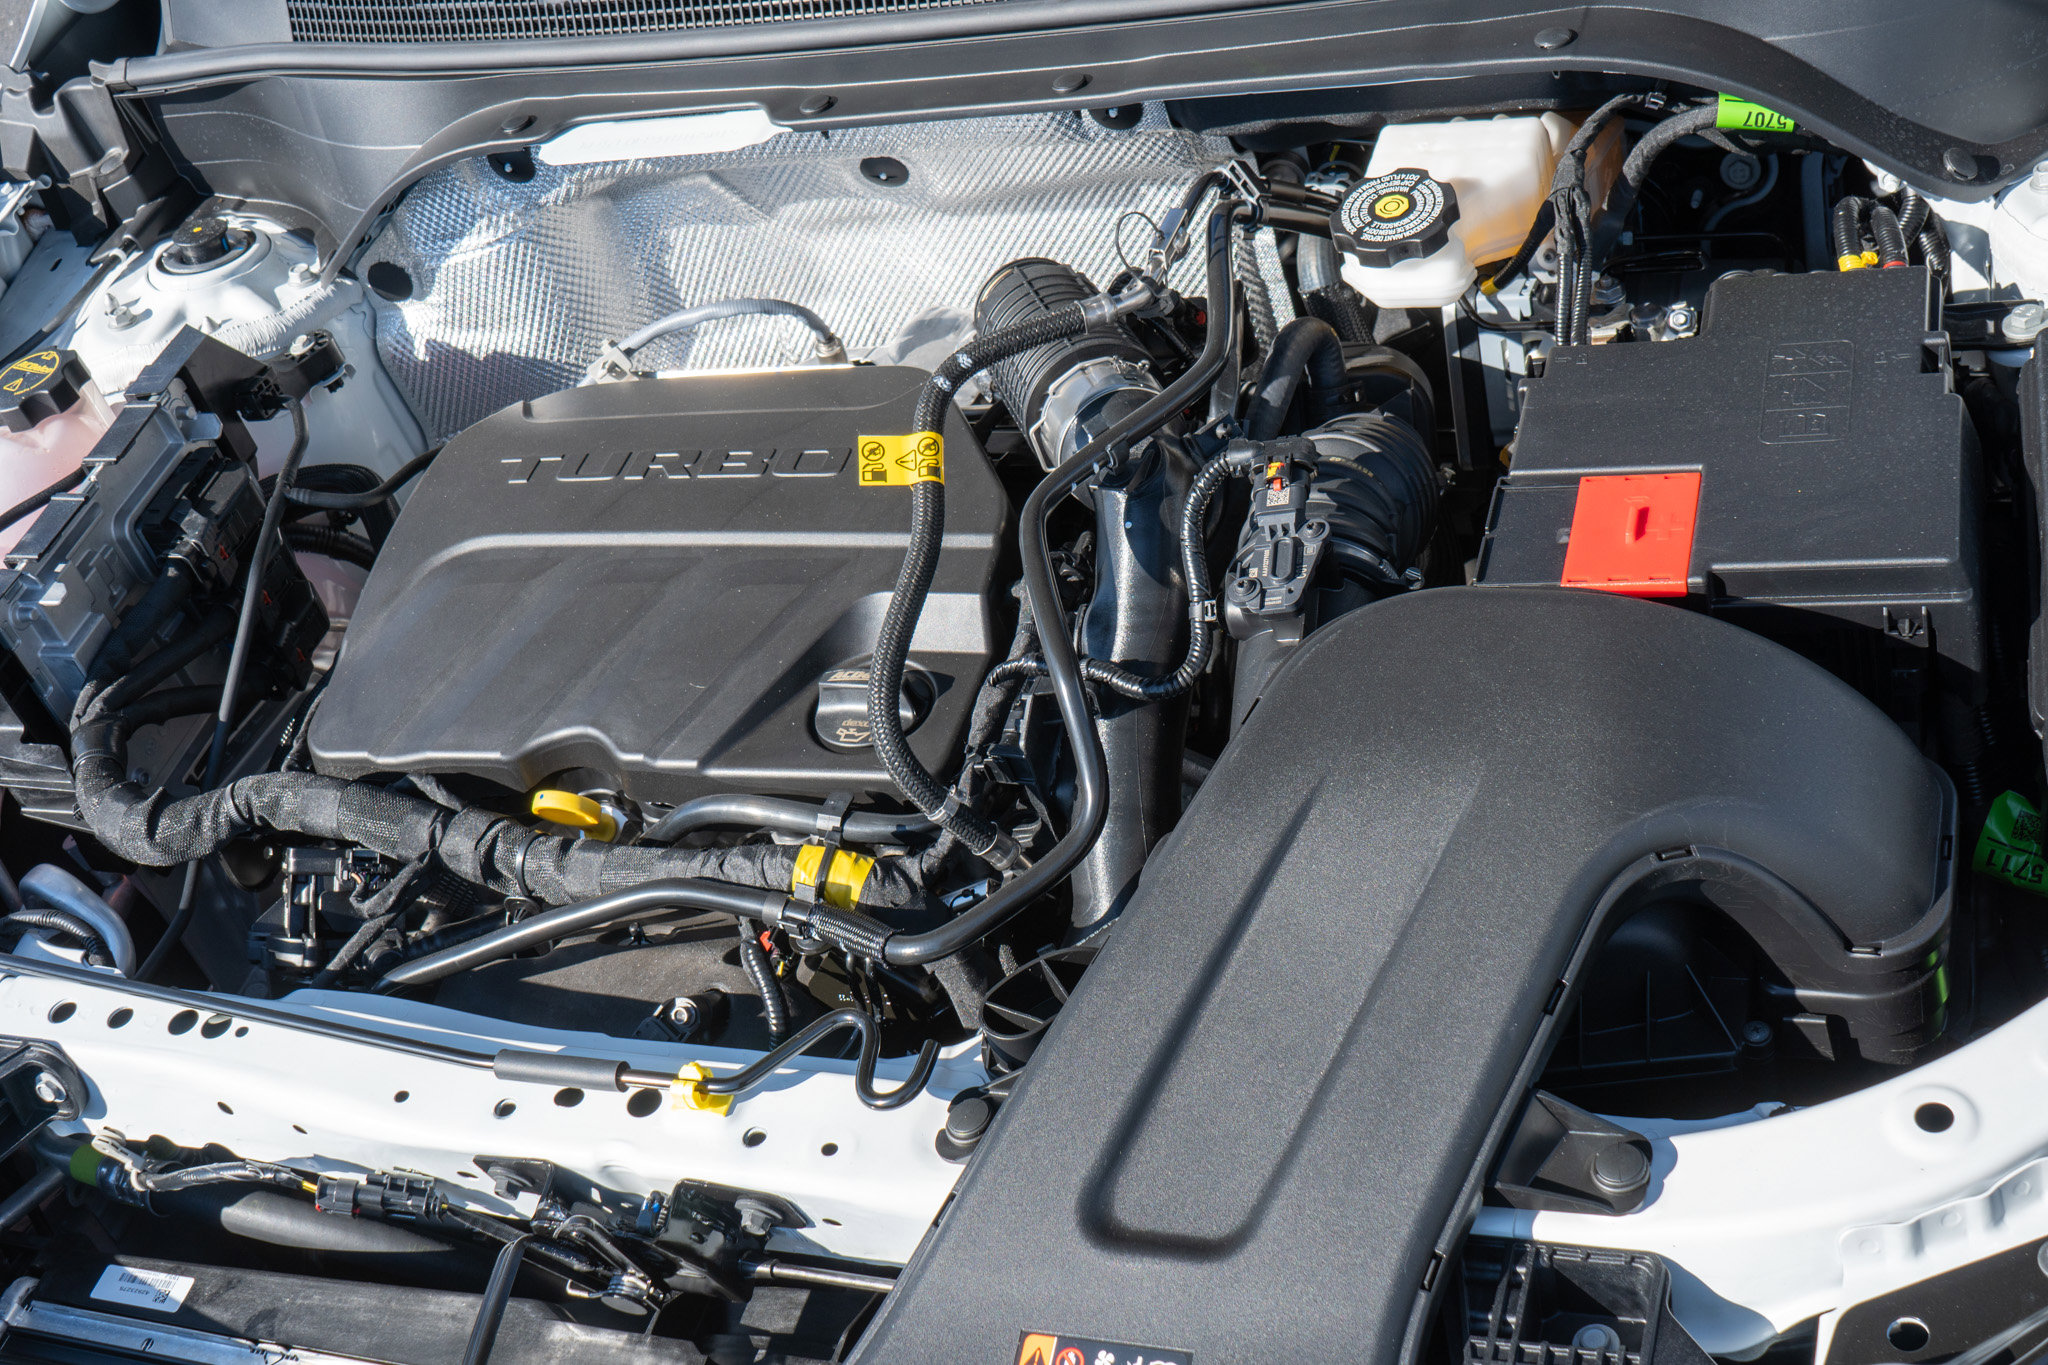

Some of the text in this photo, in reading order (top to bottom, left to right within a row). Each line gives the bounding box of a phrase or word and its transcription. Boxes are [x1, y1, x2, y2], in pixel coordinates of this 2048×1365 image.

[1743, 112, 1786, 130] 5707
[500, 448, 852, 483] TURBO
[842, 718, 870, 727] dexo
[1986, 848, 2045, 884] 5711
